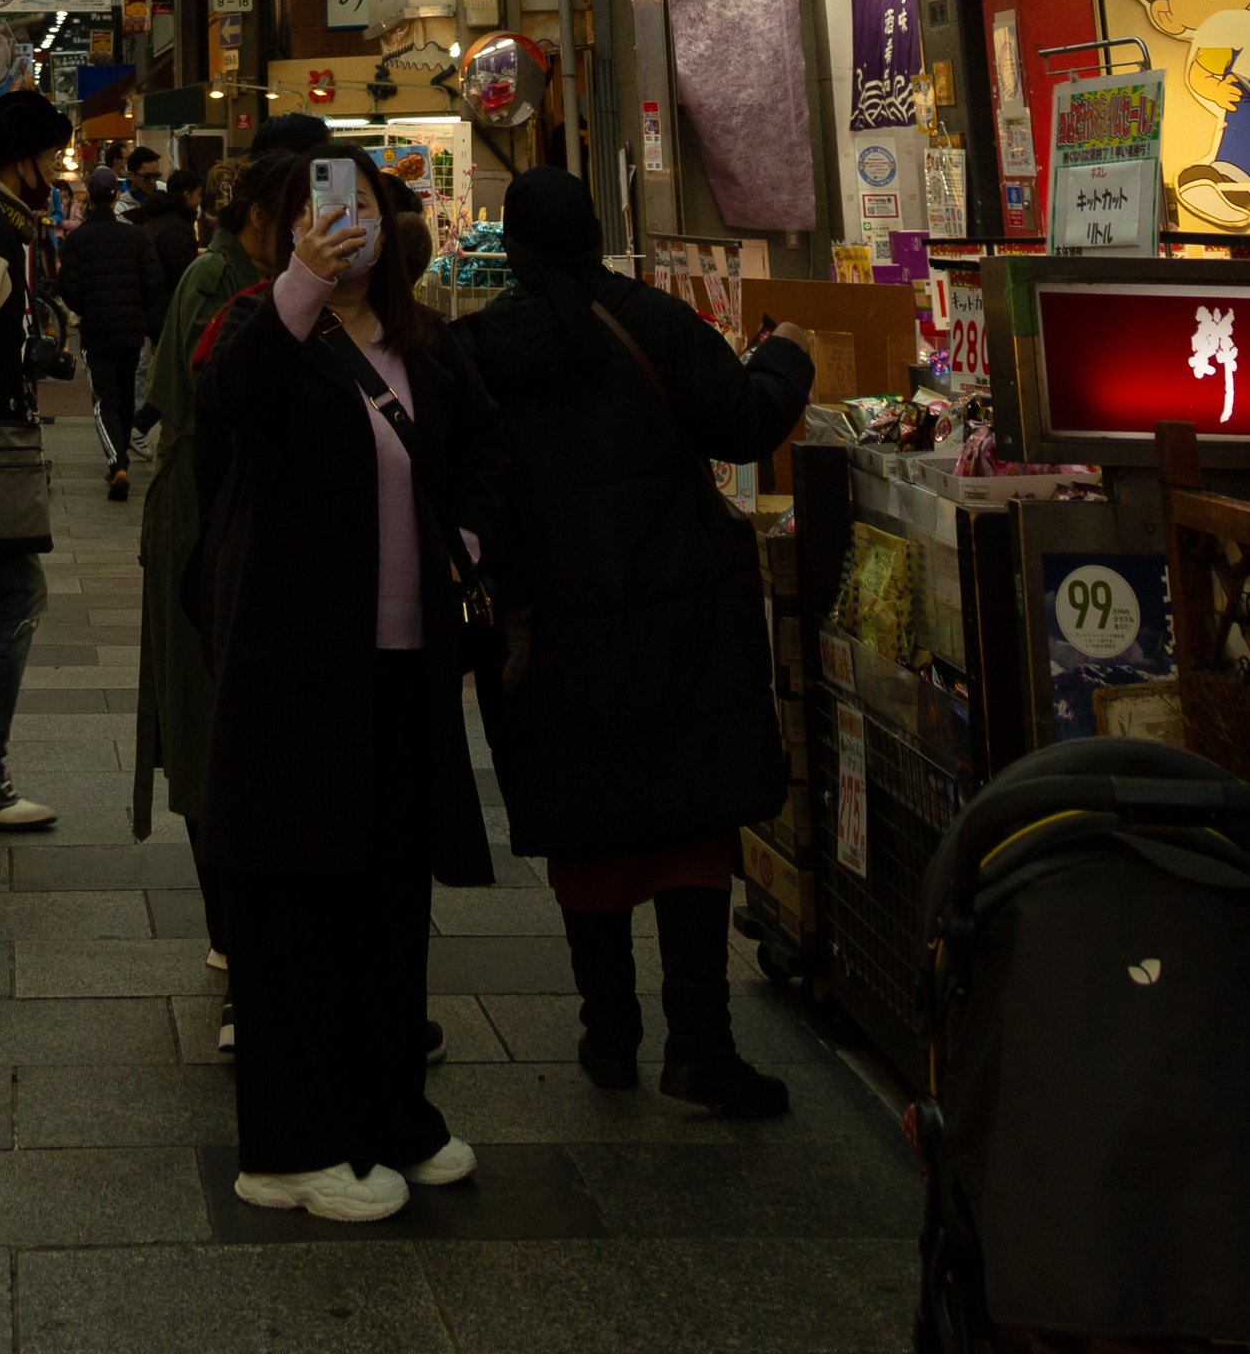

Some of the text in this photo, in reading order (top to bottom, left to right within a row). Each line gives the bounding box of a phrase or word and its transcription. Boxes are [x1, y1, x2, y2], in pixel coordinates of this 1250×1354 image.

[1077, 188, 1128, 211] キットカット
[1087, 223, 1113, 244] リトル
[1068, 579, 1112, 629] 99
